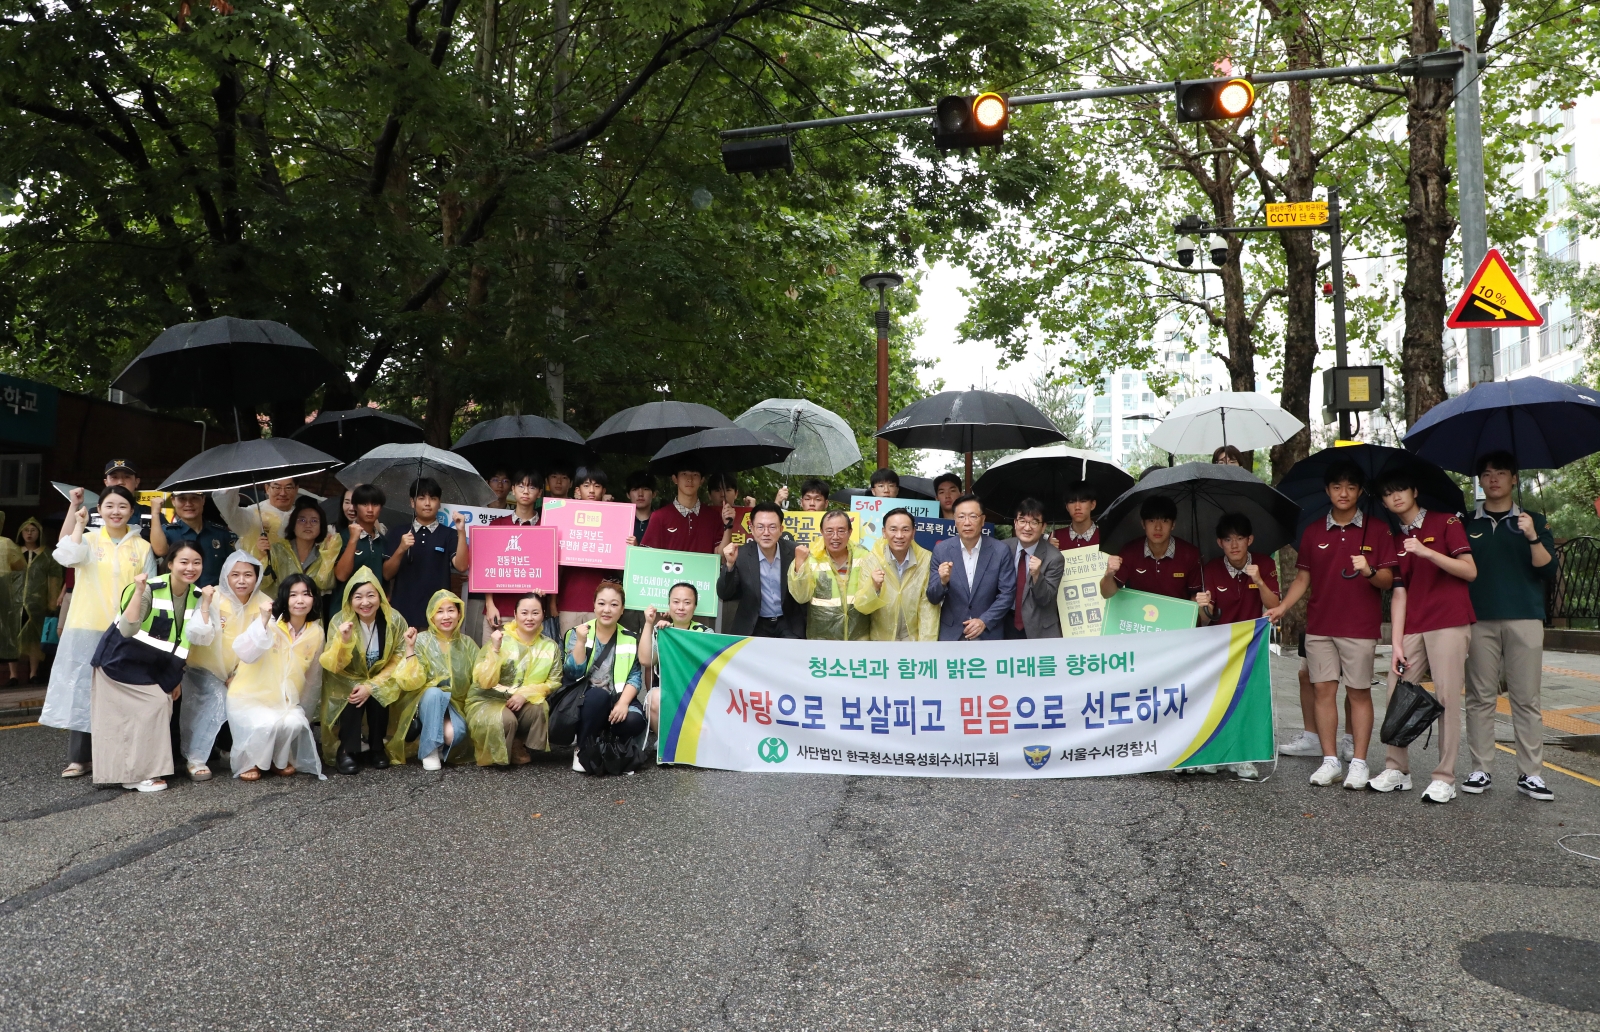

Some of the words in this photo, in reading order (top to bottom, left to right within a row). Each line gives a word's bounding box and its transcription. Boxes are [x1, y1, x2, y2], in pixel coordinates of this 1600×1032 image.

[1270, 213, 1297, 222] CCTV
[784, 516, 815, 534] 학교
[569, 529, 604, 541] 전동킥보드
[581, 542, 596, 553] 운전
[597, 543, 612, 554] 금지
[496, 556, 531, 566] 전동킥보드
[484, 568, 496, 578] 2인
[498, 567, 512, 578] 이상
[513, 567, 527, 579] 탑승
[528, 568, 542, 579] 금지
[696, 581, 711, 591] 면허
[808, 656, 889, 679] 청소년과
[897, 658, 938, 680] 함께
[946, 657, 987, 680] 밝은
[996, 655, 1057, 678] 미래를
[1065, 651, 1135, 676] 향하여!
[725, 687, 826, 729] 사랑으로
[839, 695, 945, 735] 보살피고
[960, 694, 1066, 735] 믿음으로
[1081, 683, 1188, 730] 선도하자
[796, 745, 842, 762] 사단법인
[846, 749, 999, 767] 한국청소년육성회수서지구회
[1059, 739, 1158, 762] 서울수서경찰서
